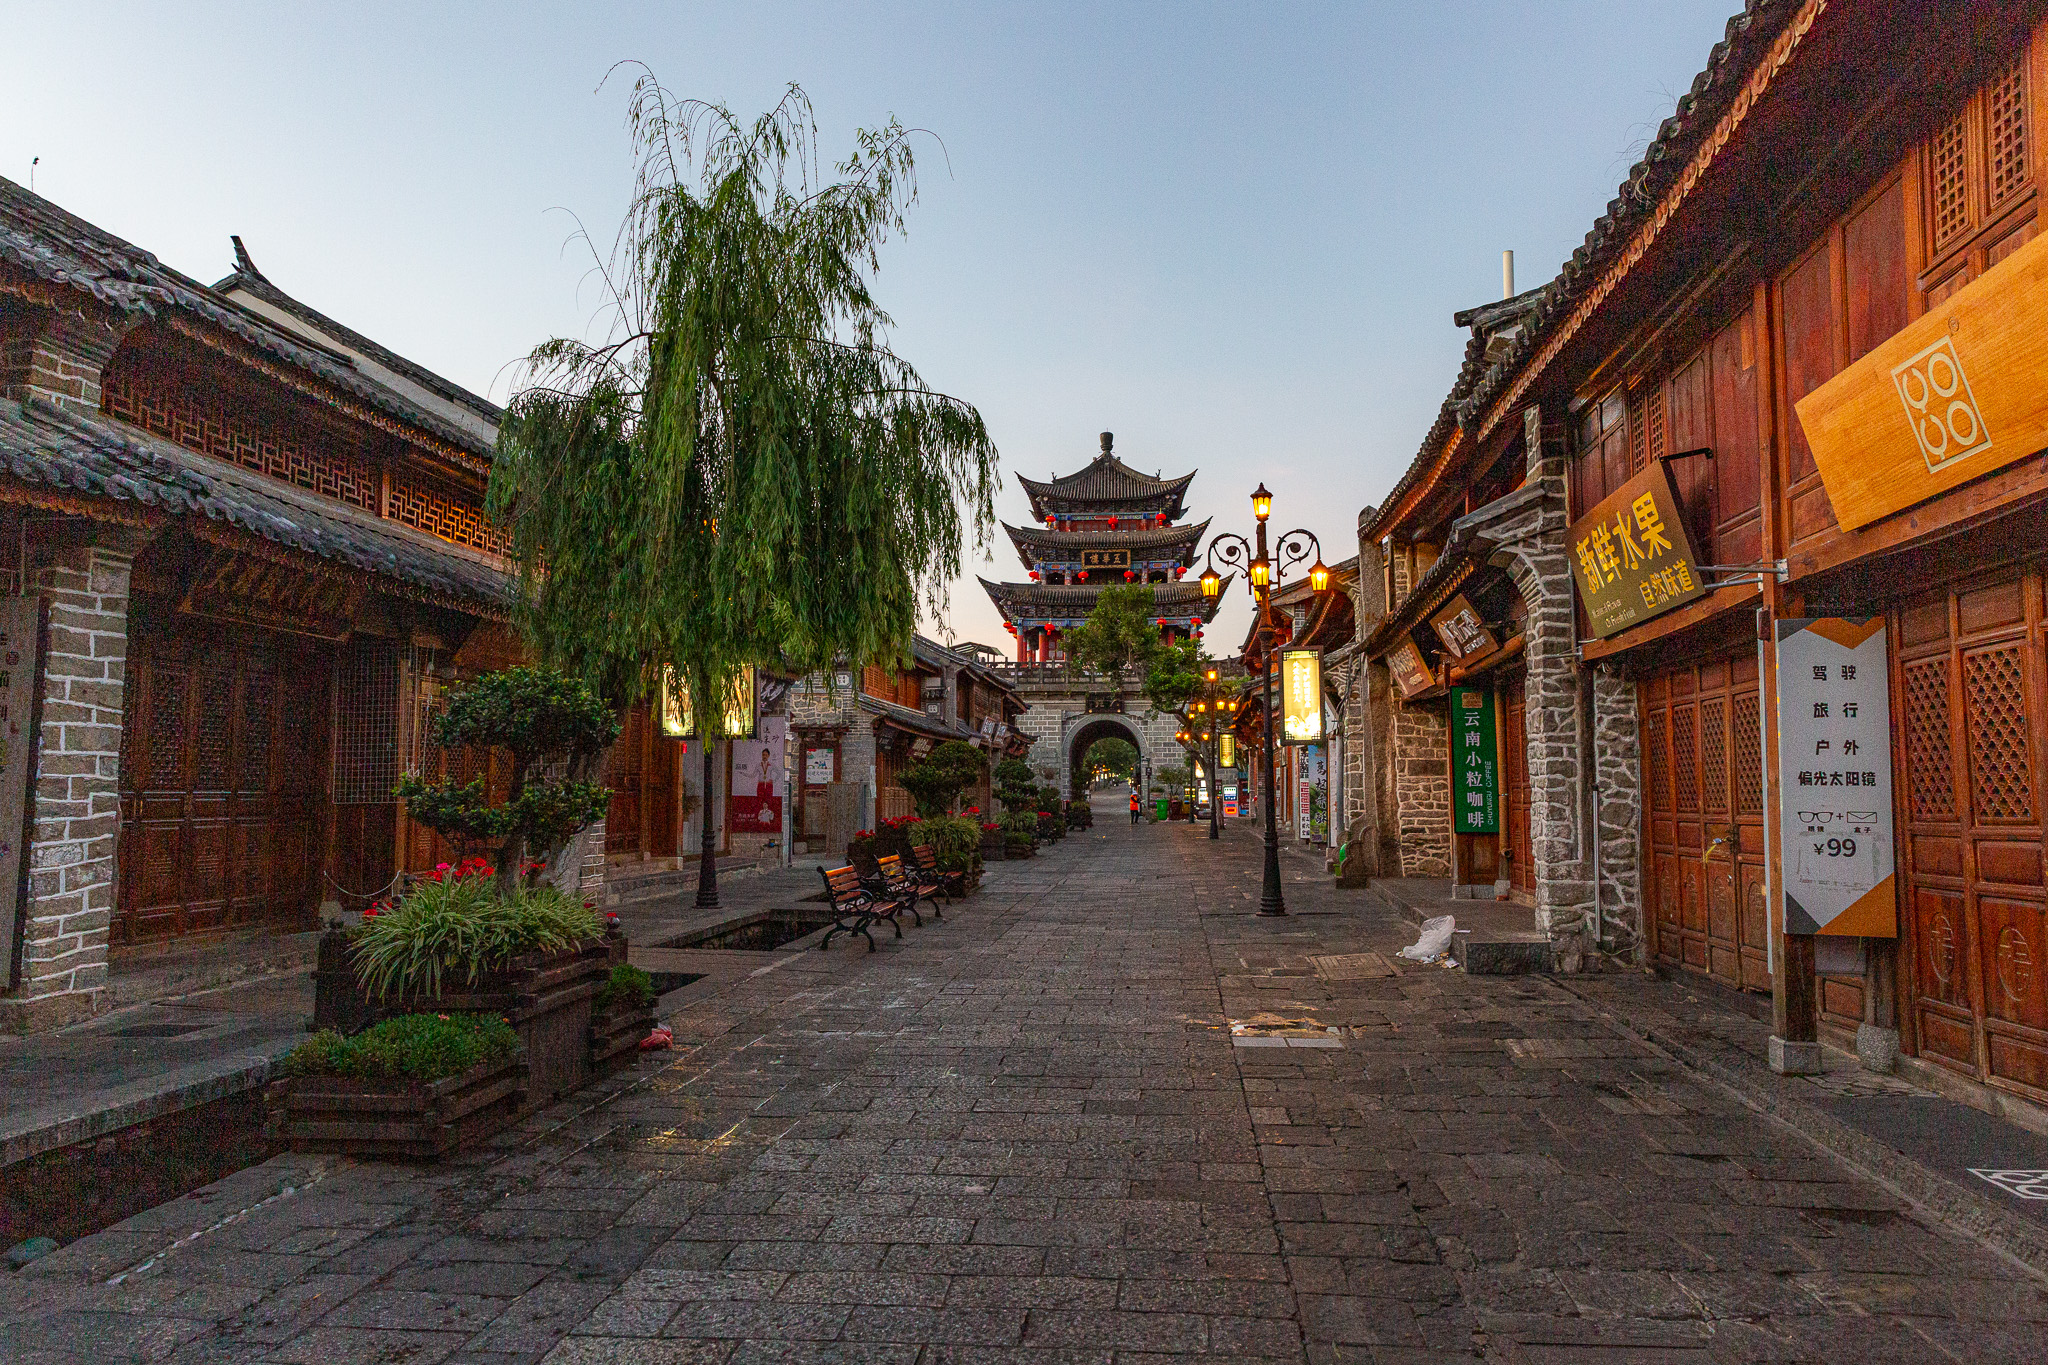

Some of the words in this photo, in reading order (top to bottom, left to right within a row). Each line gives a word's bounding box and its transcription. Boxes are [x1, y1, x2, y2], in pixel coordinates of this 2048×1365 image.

[1576, 490, 1672, 595] 新鲜水果
[1639, 558, 1695, 609] 自然味道
[1812, 665, 1857, 681] 驾驶
[1813, 702, 1859, 718] 旅行
[1815, 739, 1860, 755] 户外
[1464, 711, 1485, 828] 云南小粒咖啡
[1798, 771, 1877, 788] 偏光太阳镜
